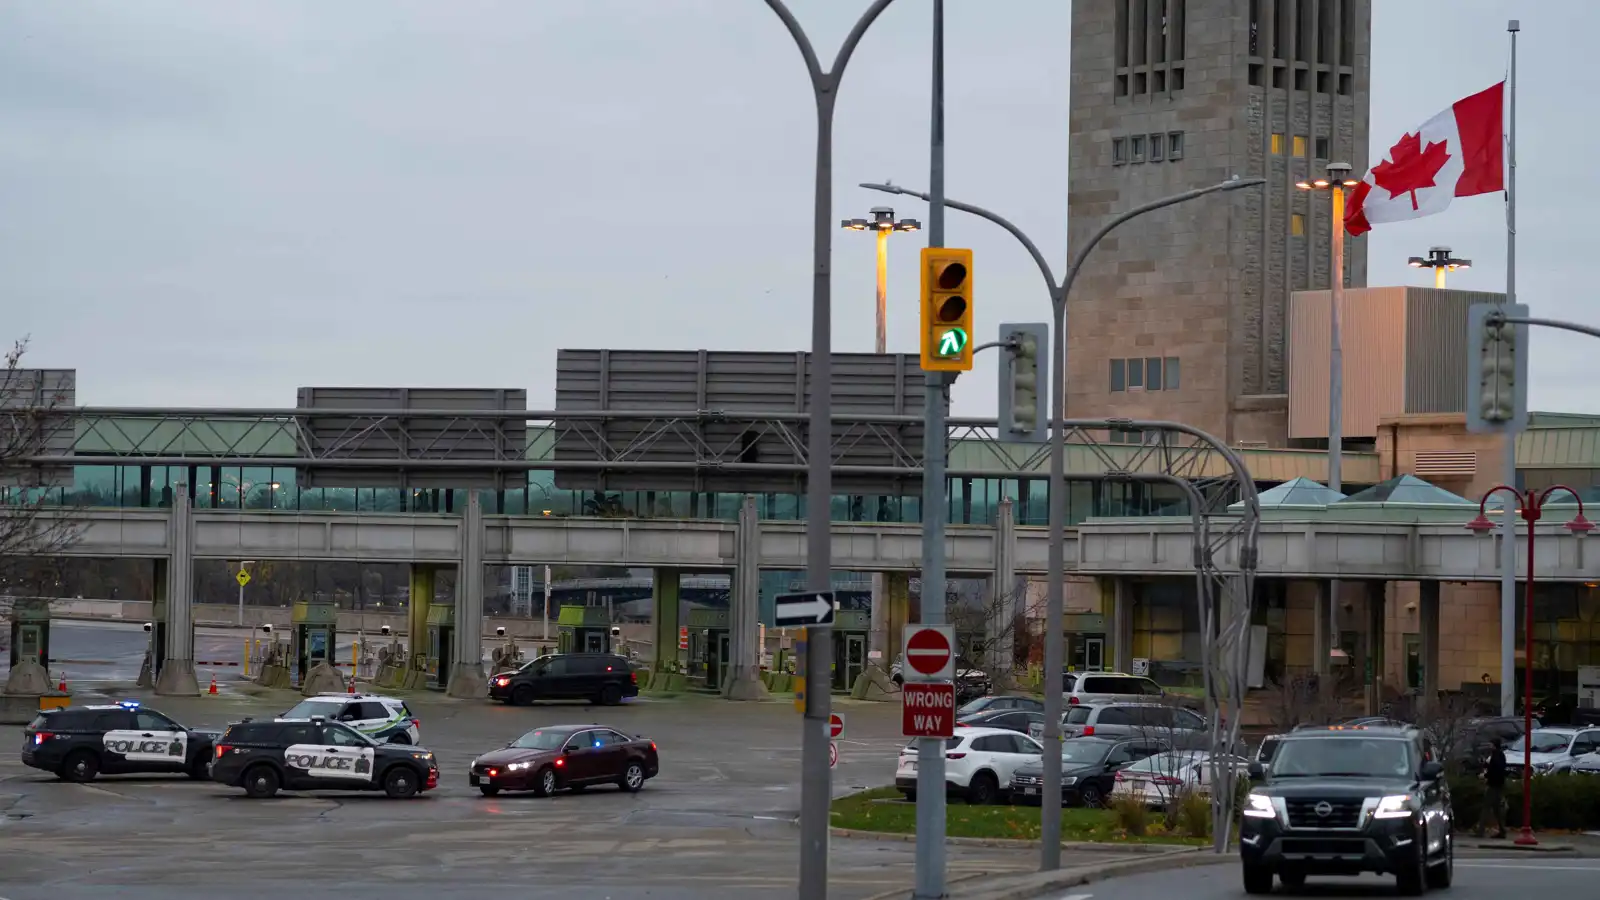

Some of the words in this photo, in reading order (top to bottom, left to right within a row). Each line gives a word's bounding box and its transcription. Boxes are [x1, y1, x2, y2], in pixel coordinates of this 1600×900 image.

[904, 691, 952, 708] WRONG
[914, 714, 942, 731] WAY
[103, 740, 168, 754] POLICE
[285, 754, 353, 770] POLICE
